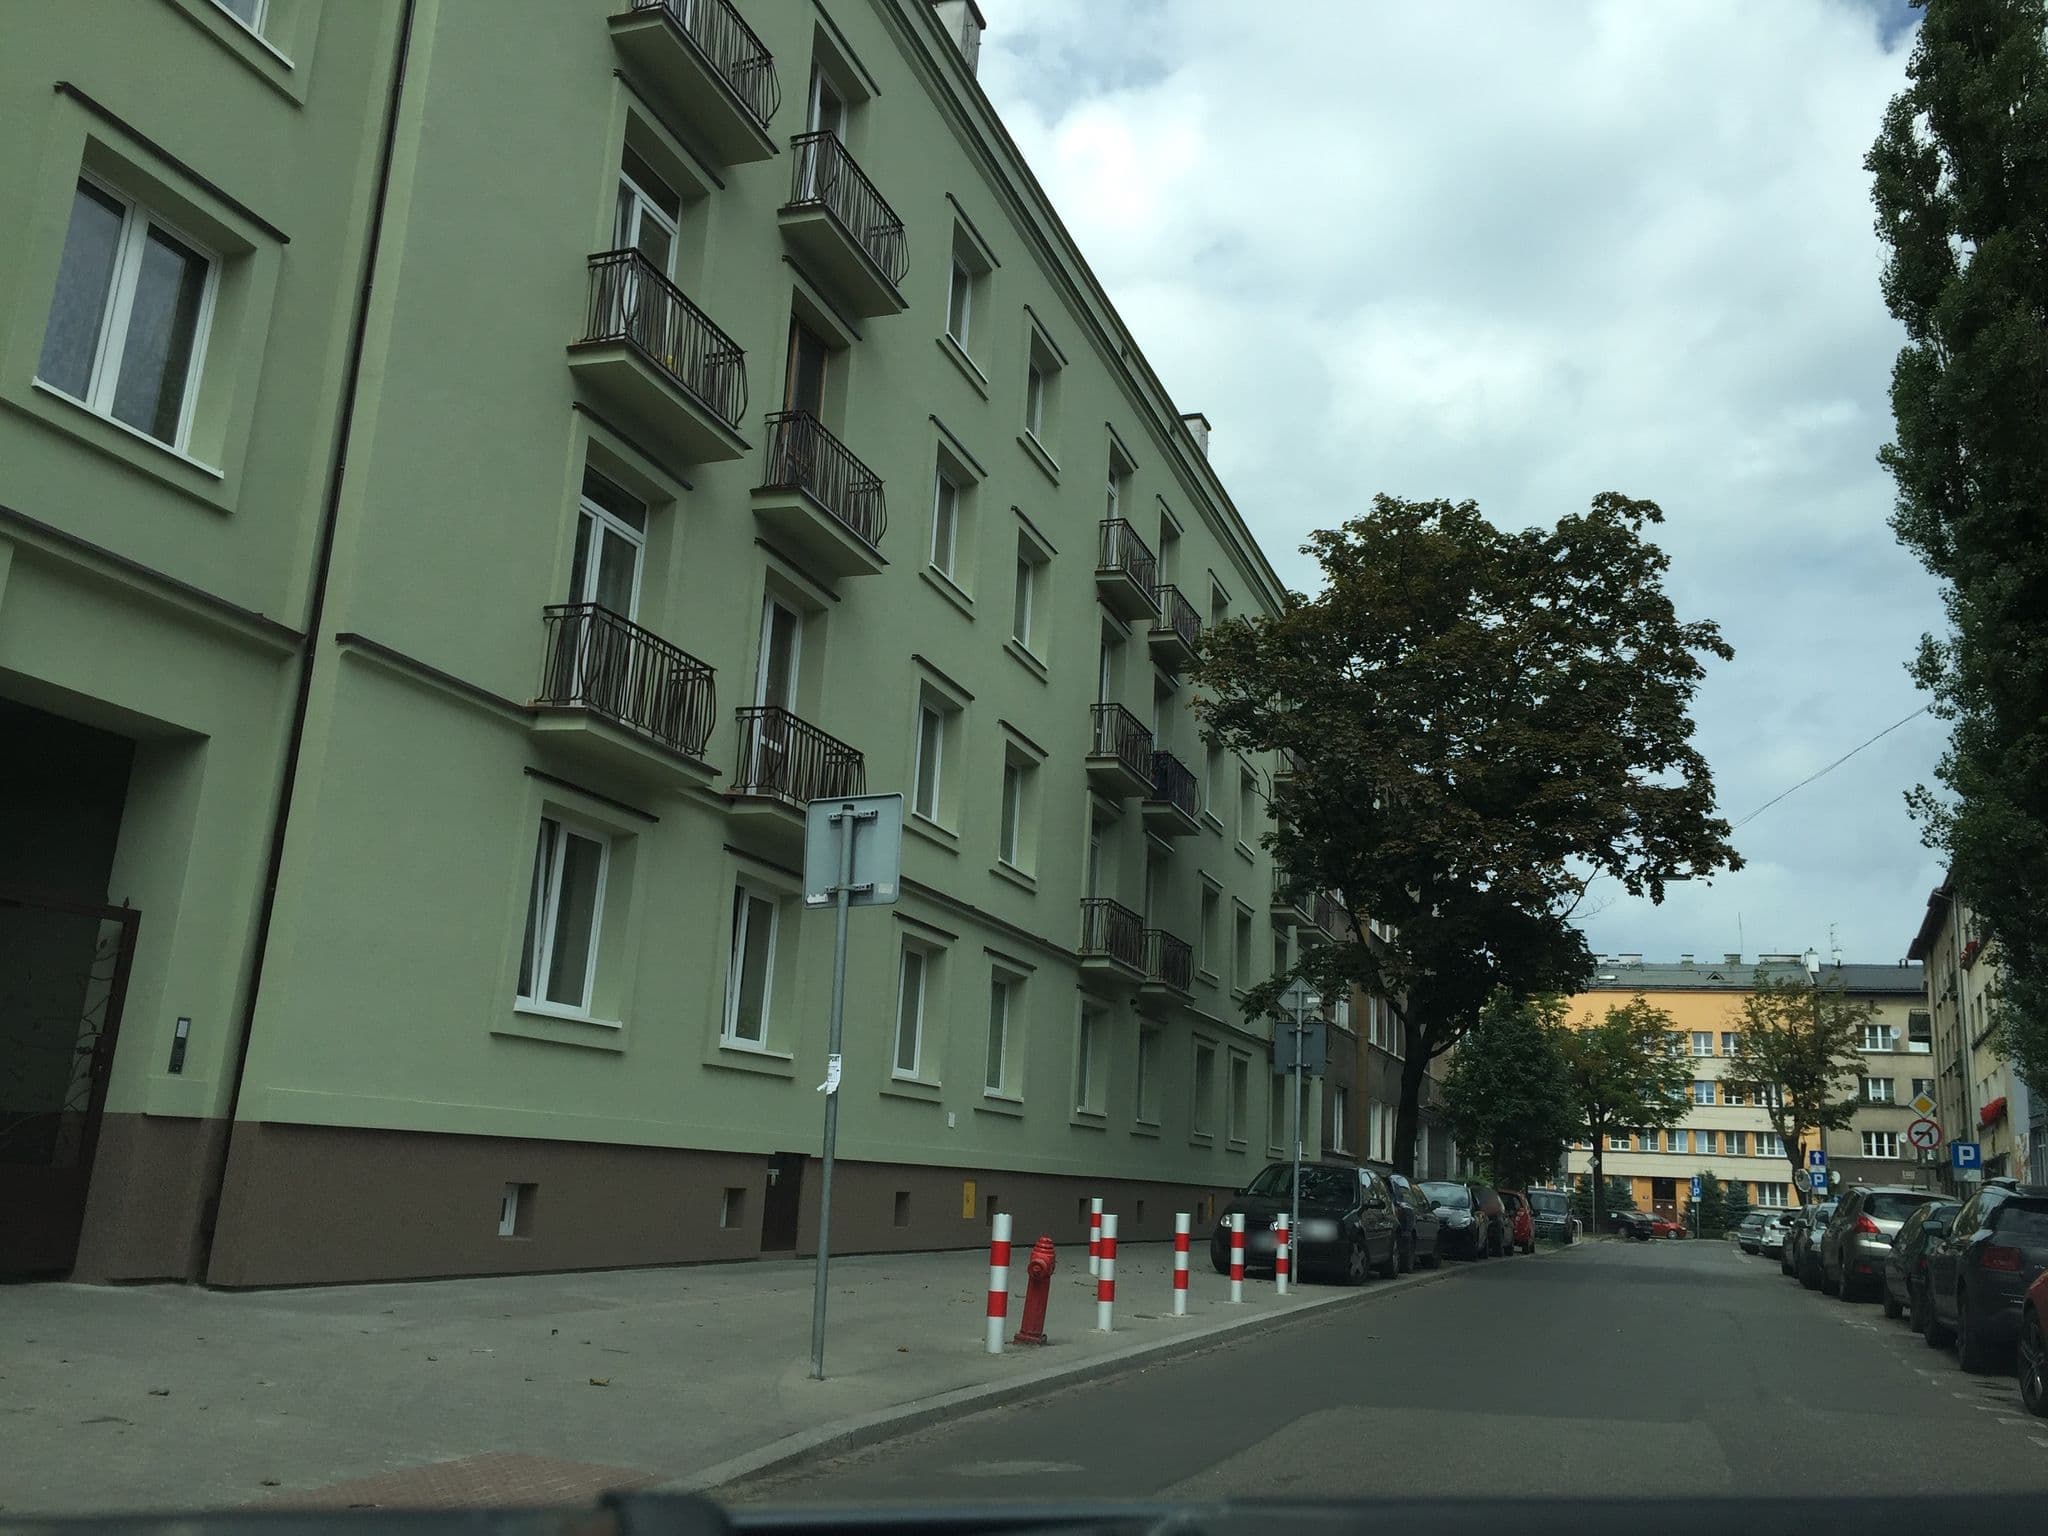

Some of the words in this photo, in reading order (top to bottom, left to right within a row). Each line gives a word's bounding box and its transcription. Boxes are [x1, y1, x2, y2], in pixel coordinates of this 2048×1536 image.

[1959, 1145, 1975, 1165] P
[1814, 1174, 1824, 1186] P
[1693, 1187, 1700, 1197] P
